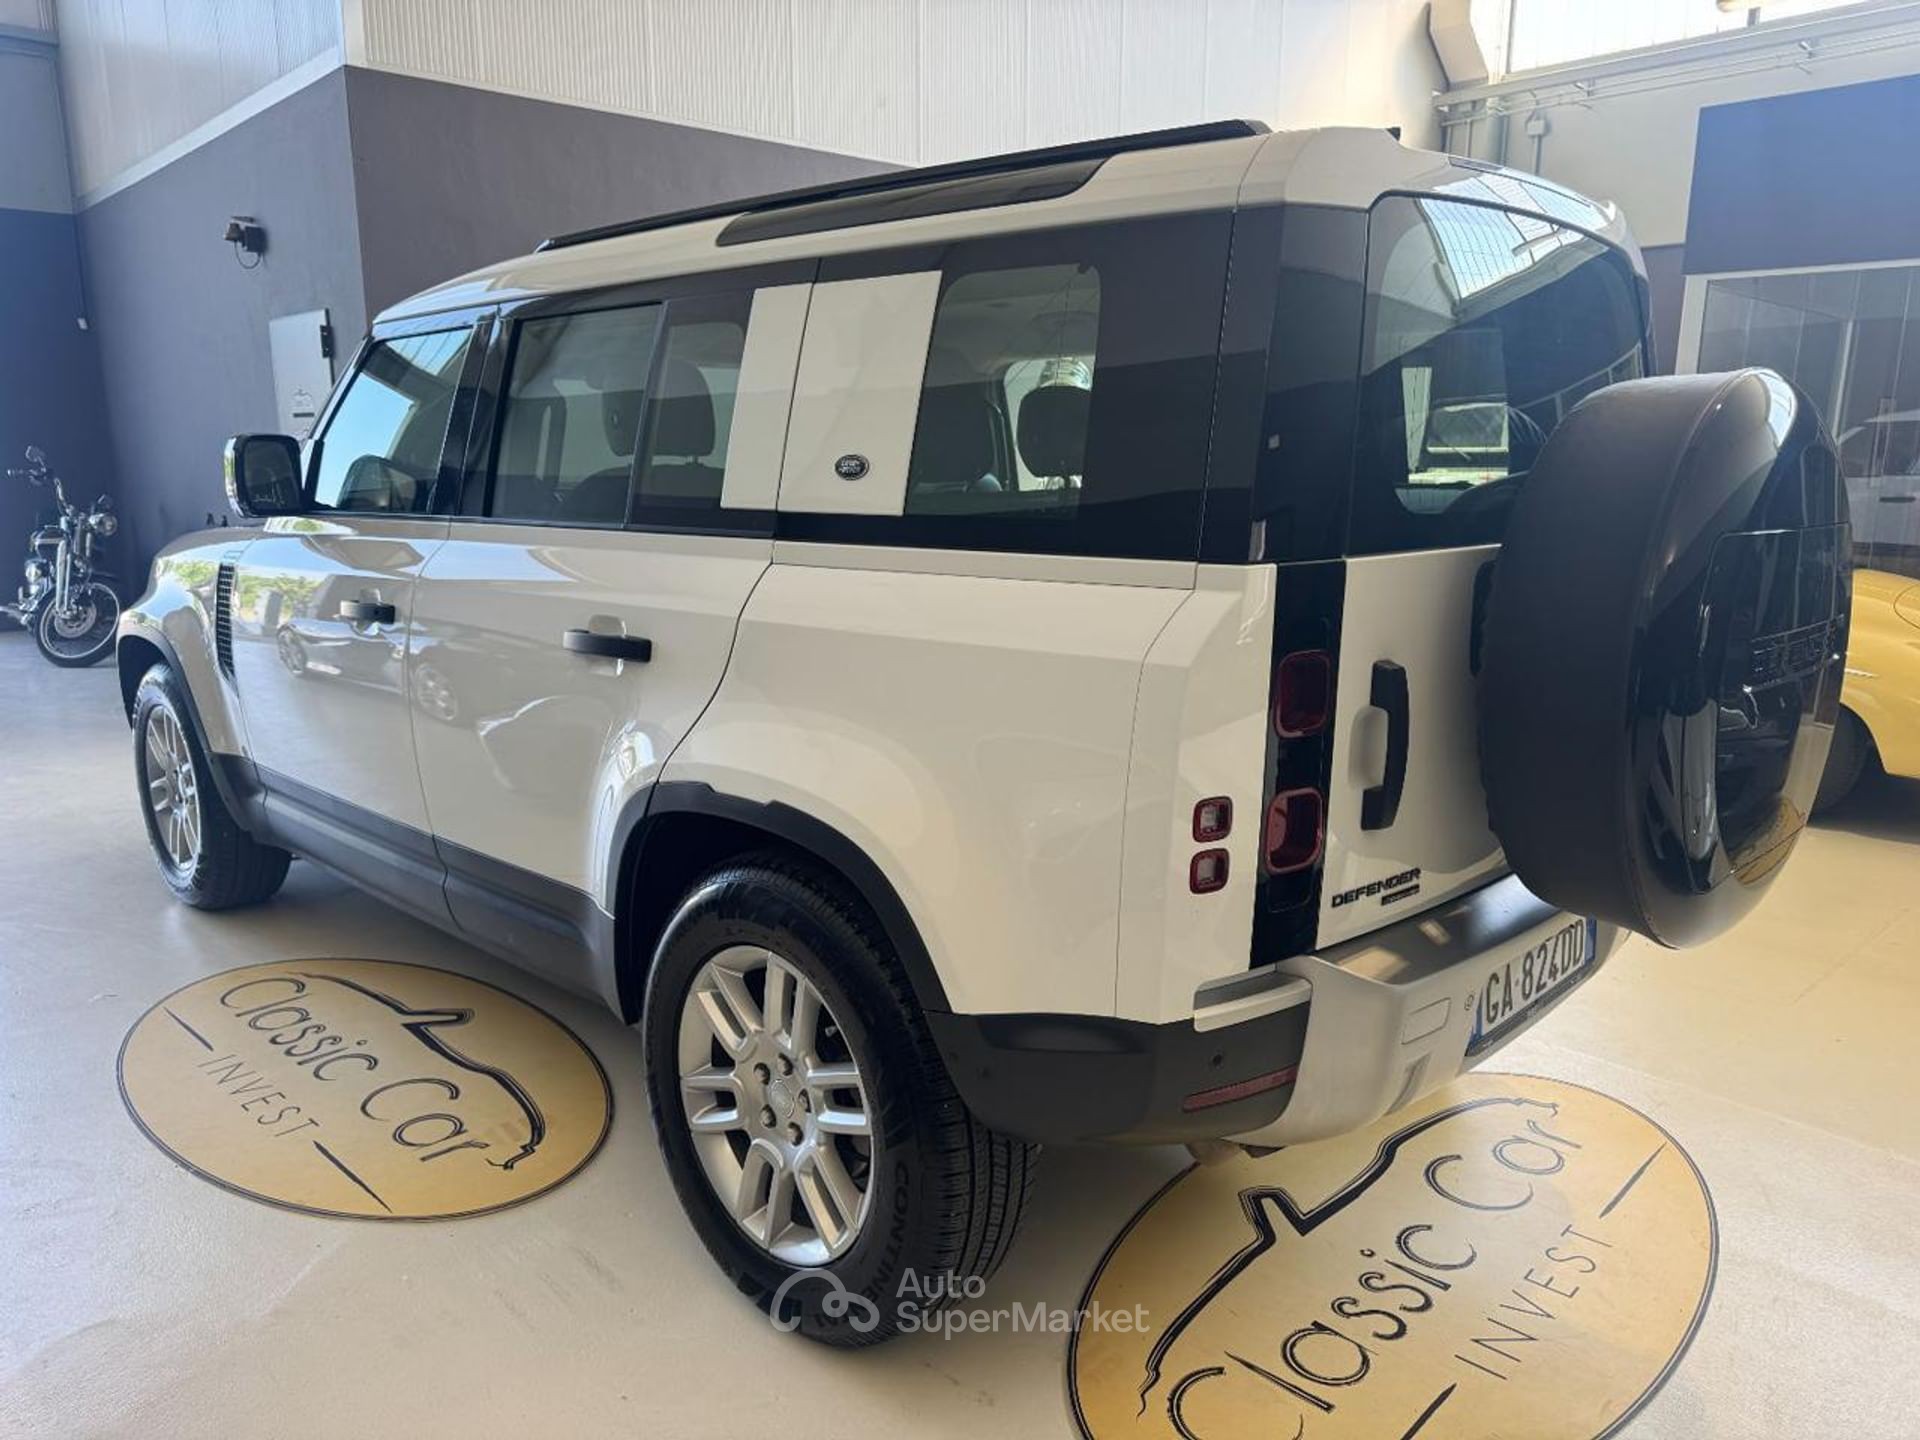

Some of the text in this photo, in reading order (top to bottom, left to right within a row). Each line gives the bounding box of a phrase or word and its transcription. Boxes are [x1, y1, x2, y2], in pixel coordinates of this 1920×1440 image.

[1331, 868, 1421, 908] DEFENDER
[198, 1055, 320, 1137] INVEST
[220, 978, 488, 1161] Classic Car
[1167, 1119, 1582, 1440] Classic Car
[1454, 1224, 1613, 1380] INVEST
